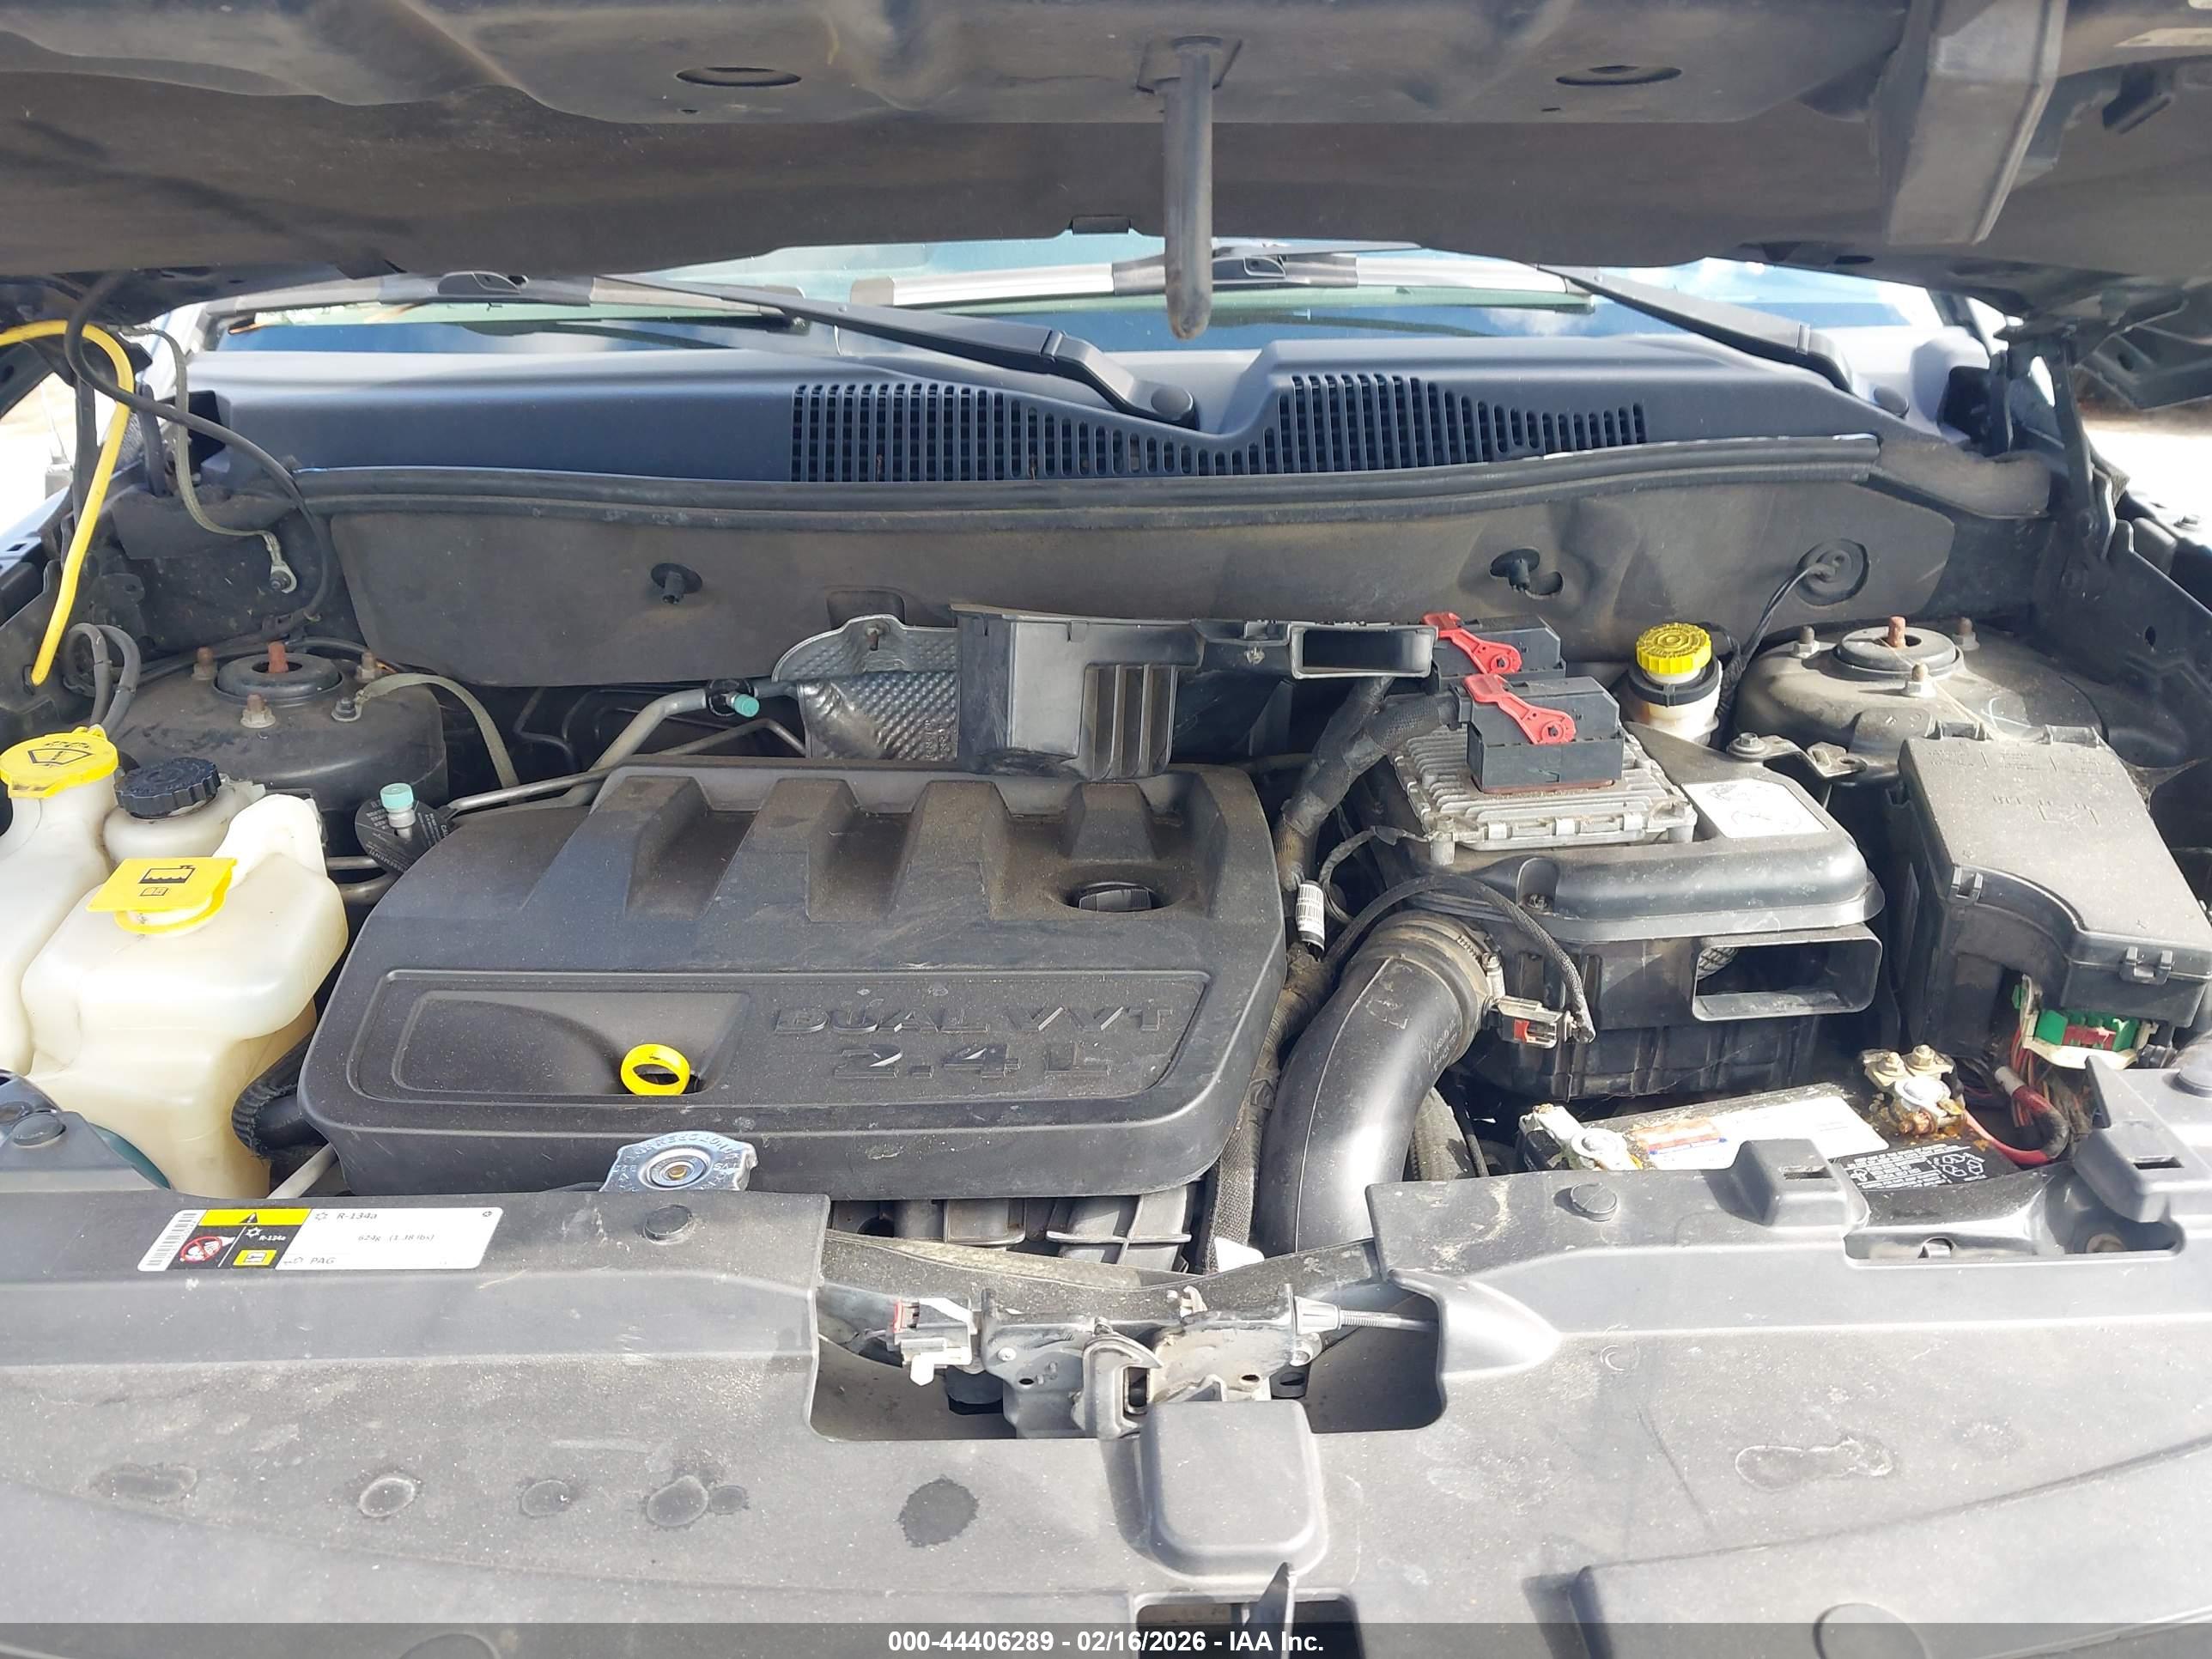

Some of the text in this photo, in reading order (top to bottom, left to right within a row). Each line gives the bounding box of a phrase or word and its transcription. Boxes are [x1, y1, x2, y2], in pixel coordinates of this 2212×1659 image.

[775, 1006, 1174, 1033] DUAL VVT
[310, 1256, 337, 1265] PAG
